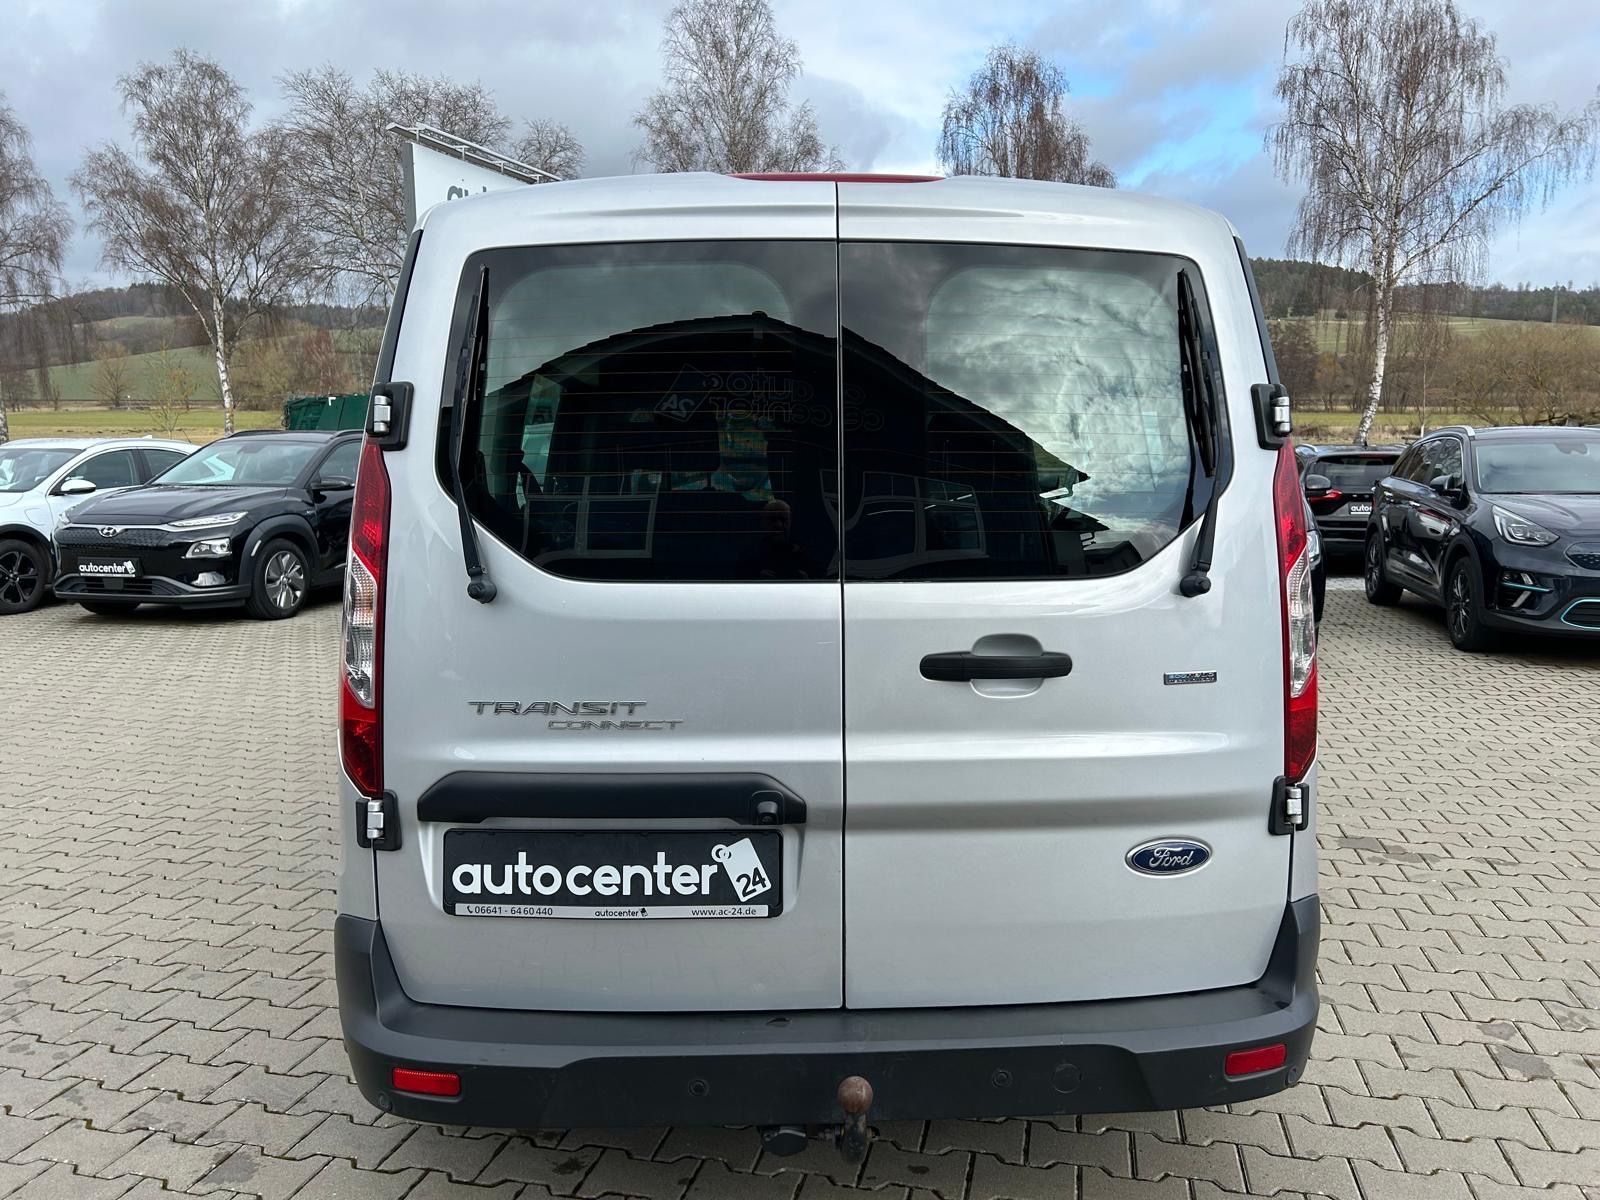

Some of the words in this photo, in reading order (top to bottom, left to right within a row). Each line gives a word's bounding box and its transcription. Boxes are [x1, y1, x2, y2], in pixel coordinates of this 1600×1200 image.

[79, 562, 126, 573] autocenter
[468, 700, 647, 716] TRANSIT
[548, 719, 684, 731] CONNECT
[1149, 847, 1194, 867] Ford
[452, 851, 718, 896] autocenter
[735, 866, 768, 898] 24
[594, 909, 639, 917] autocenter
[691, 907, 757, 916] www.ac-24.de
